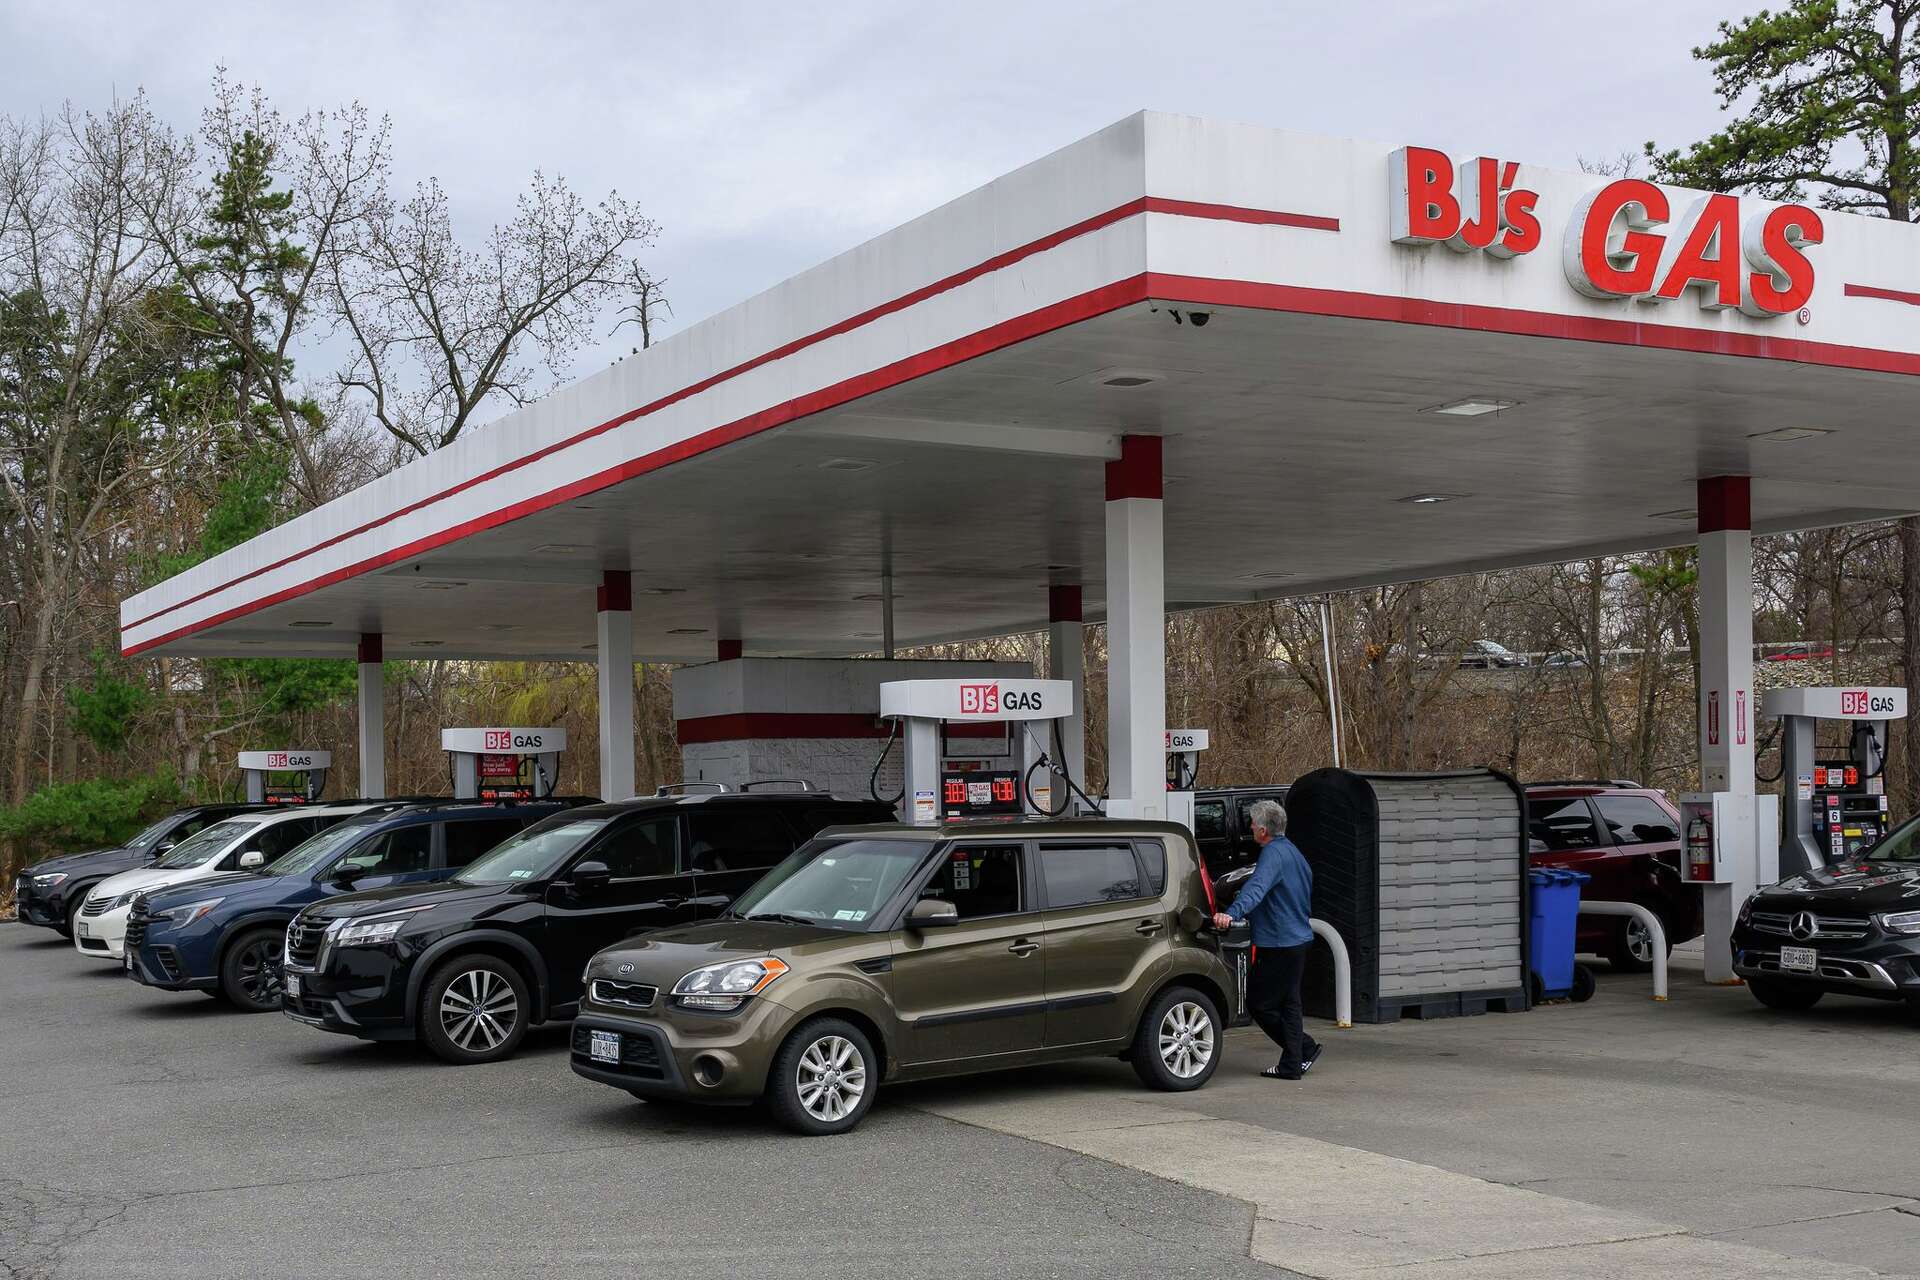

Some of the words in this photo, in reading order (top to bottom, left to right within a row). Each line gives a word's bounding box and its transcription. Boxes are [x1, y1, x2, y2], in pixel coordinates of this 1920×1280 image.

[1403, 145, 1542, 256] BJ's
[1578, 177, 1825, 315] GAS
[962, 681, 999, 713] BJ's
[1002, 691, 1043, 711] GAS
[1842, 688, 1868, 714] BJ's
[1870, 697, 1895, 712] GAS
[485, 730, 511, 749] BJ's
[514, 735, 543, 747] GAS
[1172, 735, 1194, 747] GAS
[289, 756, 312, 766] GAS
[1832, 811, 1838, 821] 6
